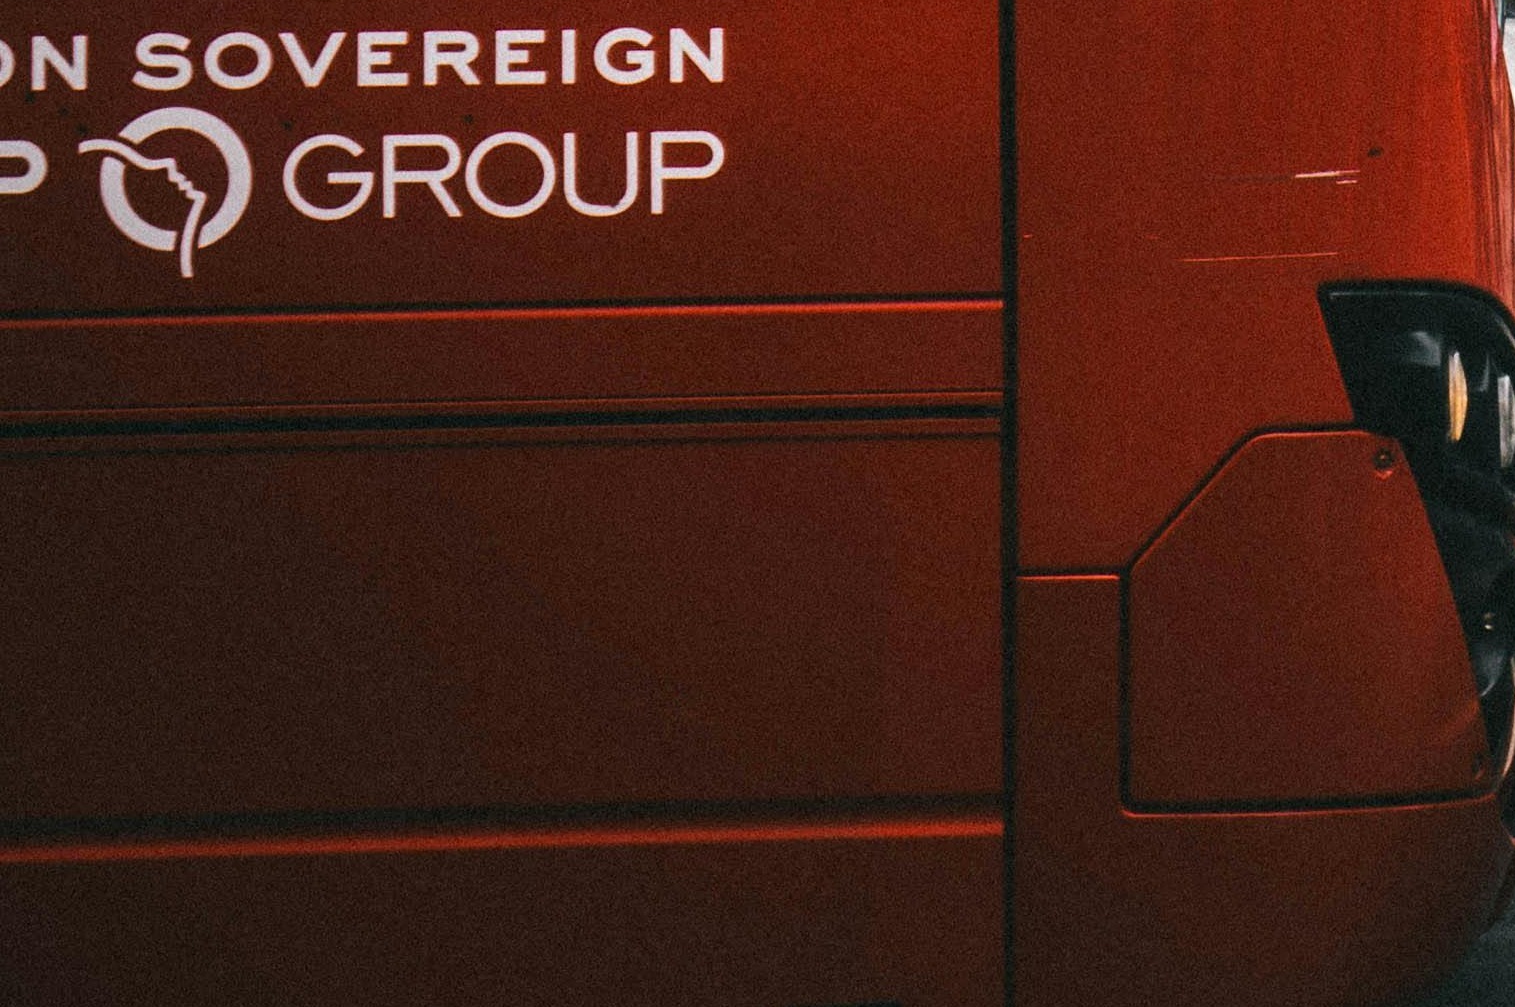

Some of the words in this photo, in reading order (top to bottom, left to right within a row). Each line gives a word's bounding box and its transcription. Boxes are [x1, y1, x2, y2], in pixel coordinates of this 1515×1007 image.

[0, 35, 88, 91] N
[133, 27, 725, 91] SOVEREIGN
[283, 131, 725, 220] GROUP
